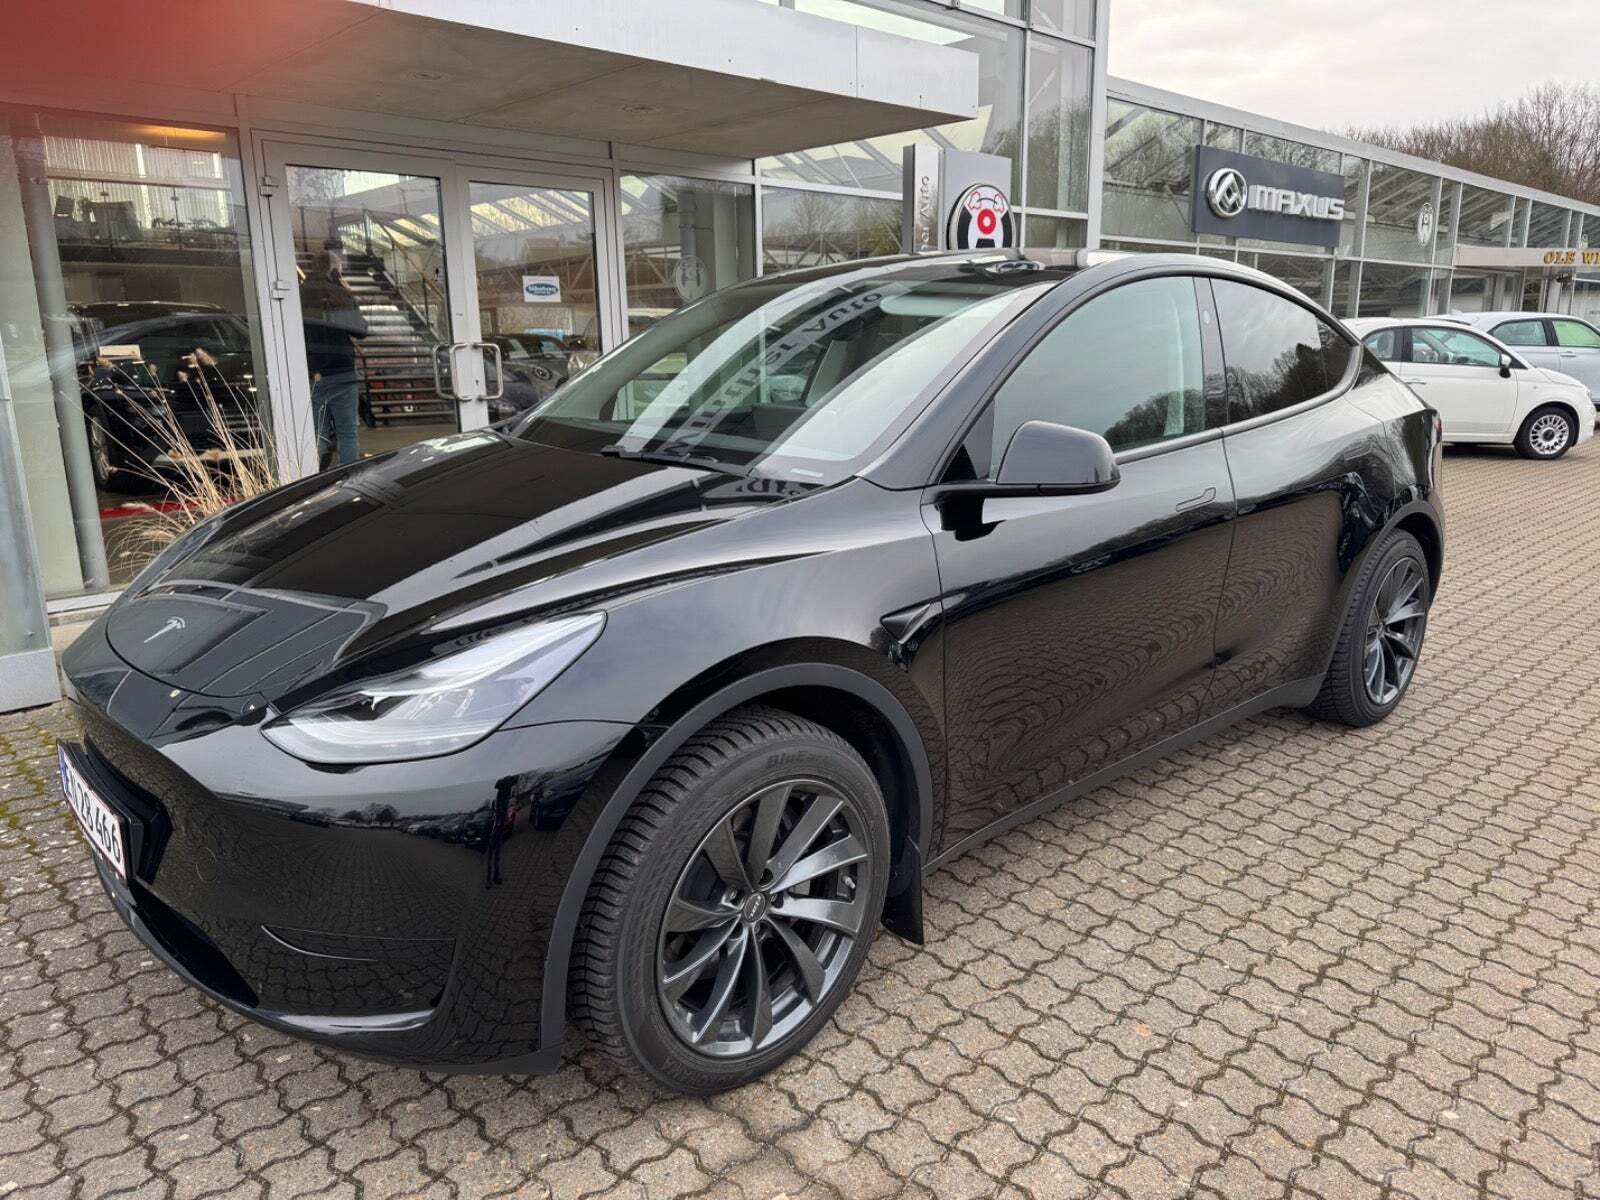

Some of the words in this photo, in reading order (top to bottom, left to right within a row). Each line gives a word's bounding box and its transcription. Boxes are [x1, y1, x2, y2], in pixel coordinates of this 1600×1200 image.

[1247, 184, 1345, 220] MAXUS
[1543, 251, 1576, 265] OLE
[95, 806, 121, 863] 466
